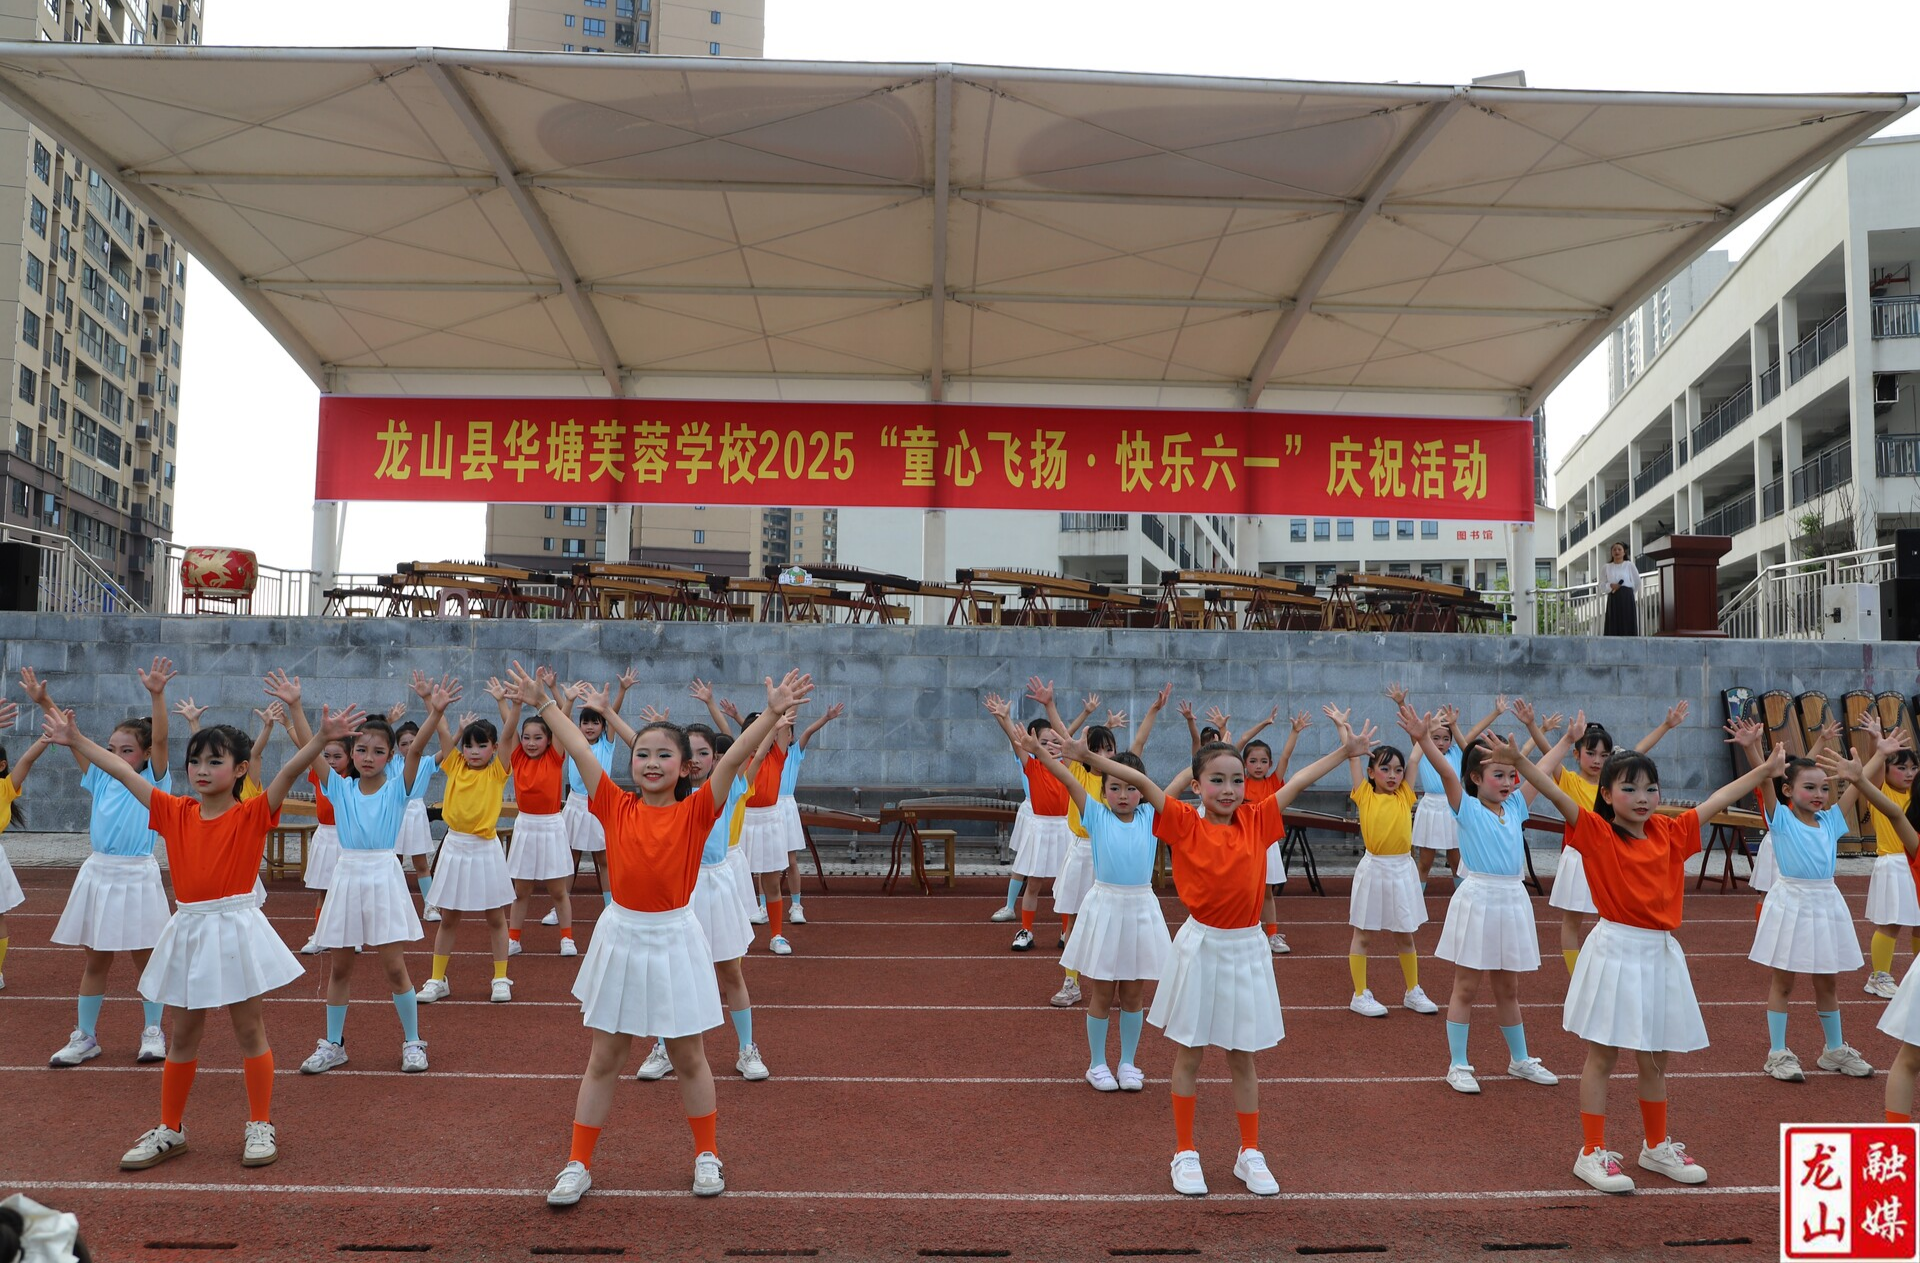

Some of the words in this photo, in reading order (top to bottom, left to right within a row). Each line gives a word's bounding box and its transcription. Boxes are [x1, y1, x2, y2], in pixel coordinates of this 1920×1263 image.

[374, 419, 856, 486] 龙山县华塘芙蓉学校2025
[1327, 436, 1489, 502] 庆祝活动
[1456, 529, 1494, 540] 图书馆
